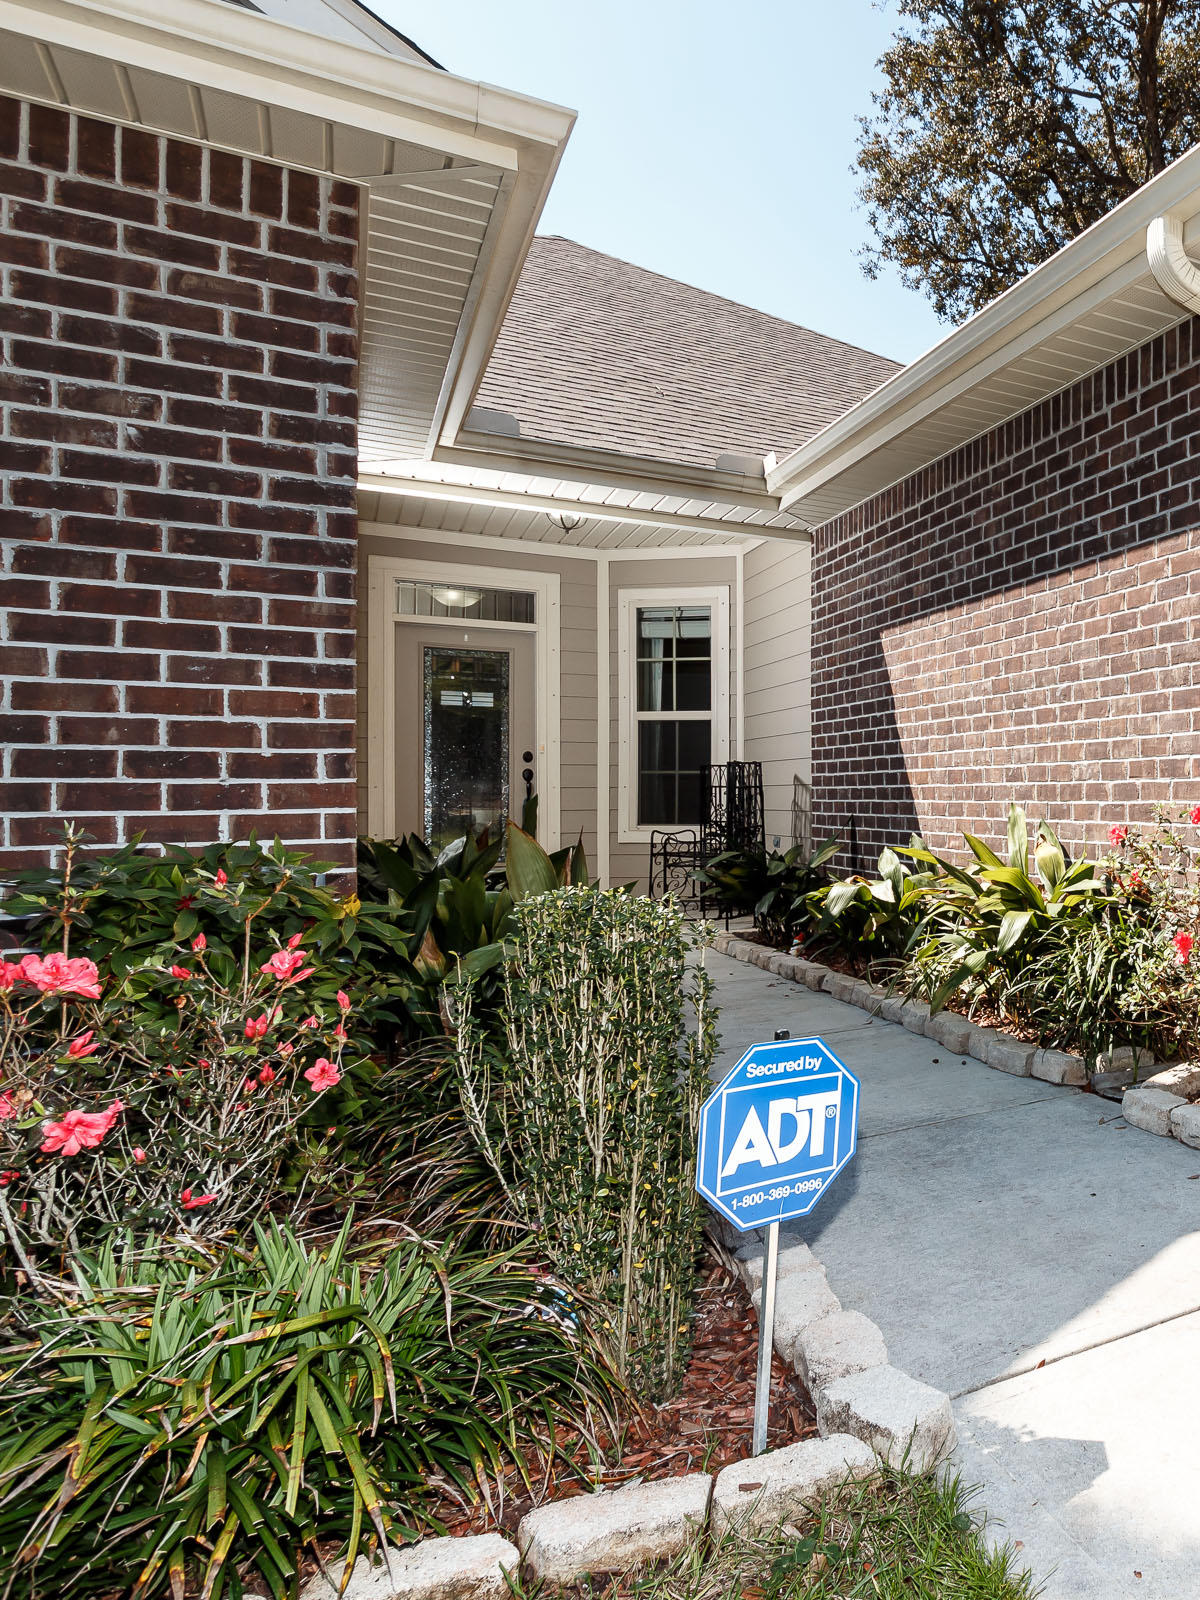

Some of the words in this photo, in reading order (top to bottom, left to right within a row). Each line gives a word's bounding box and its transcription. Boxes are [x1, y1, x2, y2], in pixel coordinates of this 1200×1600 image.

[746, 1056, 805, 1078] Secured
[806, 1056, 822, 1071] by
[731, 1178, 823, 1210] 1-800-369-0996
